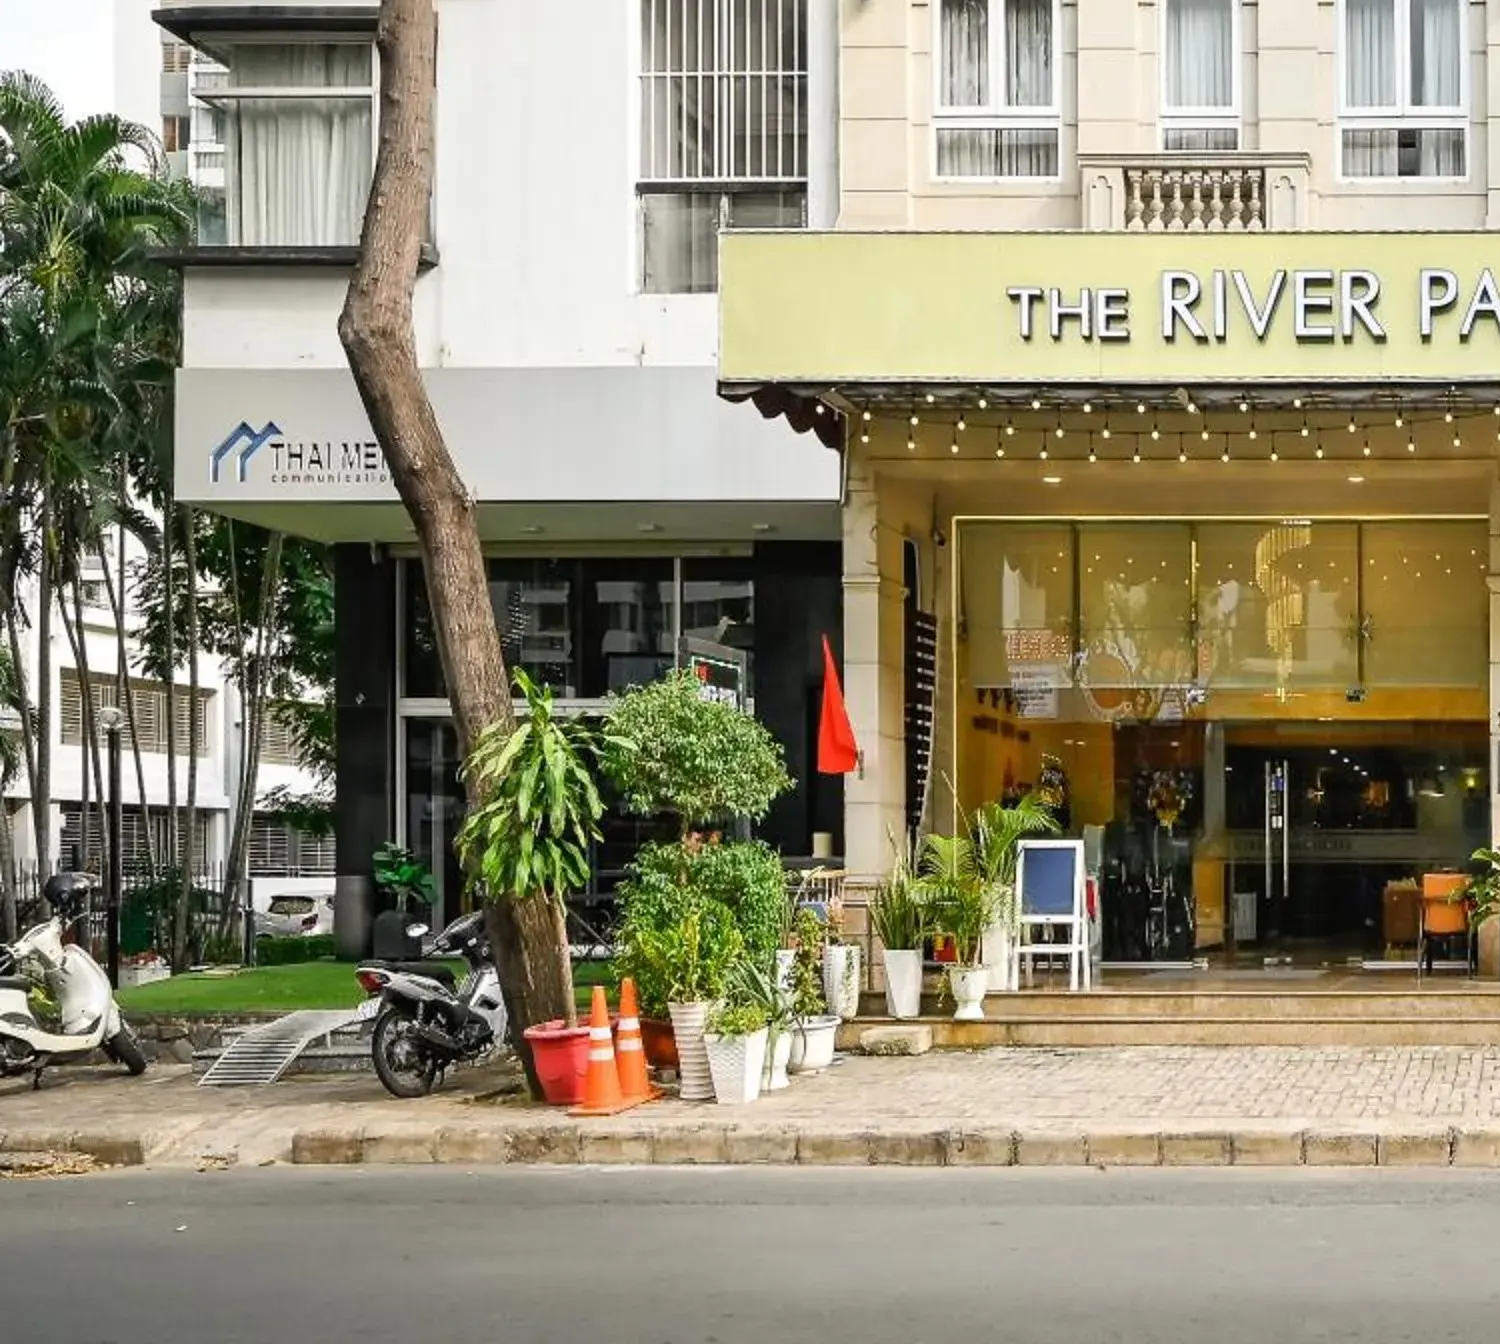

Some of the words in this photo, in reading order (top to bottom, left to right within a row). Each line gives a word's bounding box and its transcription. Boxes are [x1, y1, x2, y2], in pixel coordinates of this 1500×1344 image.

[1006, 287, 1131, 341] THE
[1160, 269, 1387, 343] RIVER
[269, 442, 332, 471] THAI
[341, 442, 383, 471] ME
